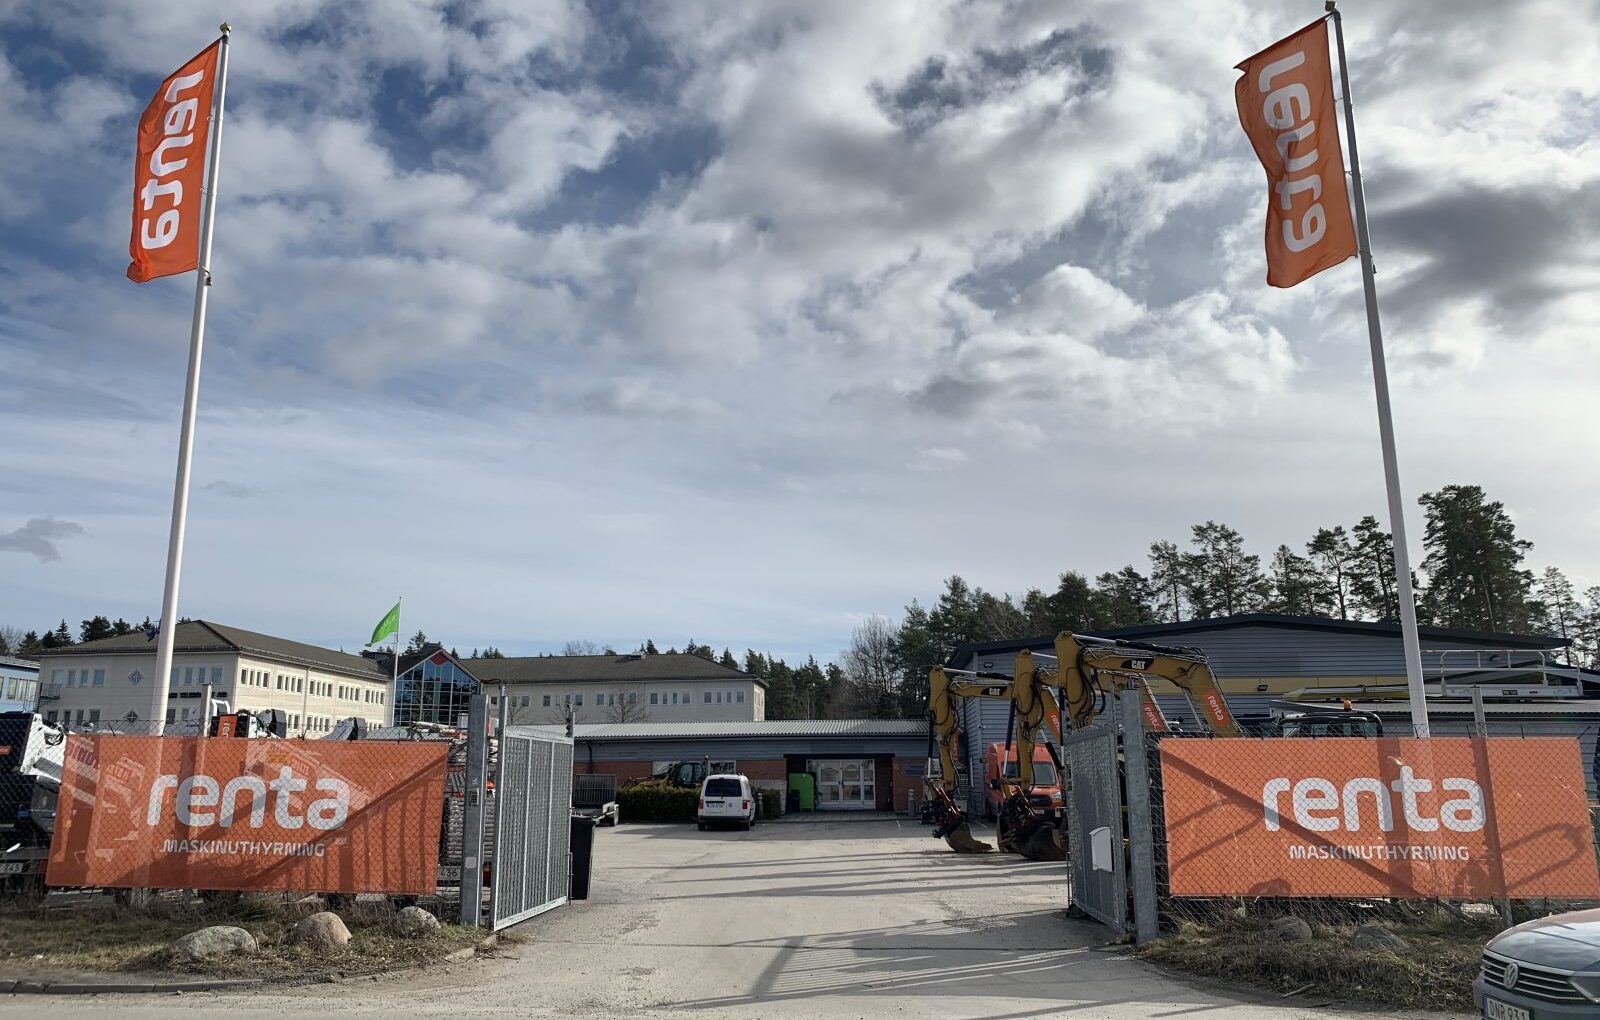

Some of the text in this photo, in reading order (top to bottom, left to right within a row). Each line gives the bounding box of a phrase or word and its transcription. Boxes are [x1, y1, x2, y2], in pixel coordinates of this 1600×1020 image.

[1131, 660, 1146, 670] CAT
[989, 688, 1001, 696] CAT
[1208, 695, 1224, 721] renta
[147, 765, 351, 831] renta
[1262, 765, 1486, 833] renta
[163, 838, 326, 858] MASKINUTHYRNING
[1289, 844, 1470, 861] MASKINUTHYRNING
